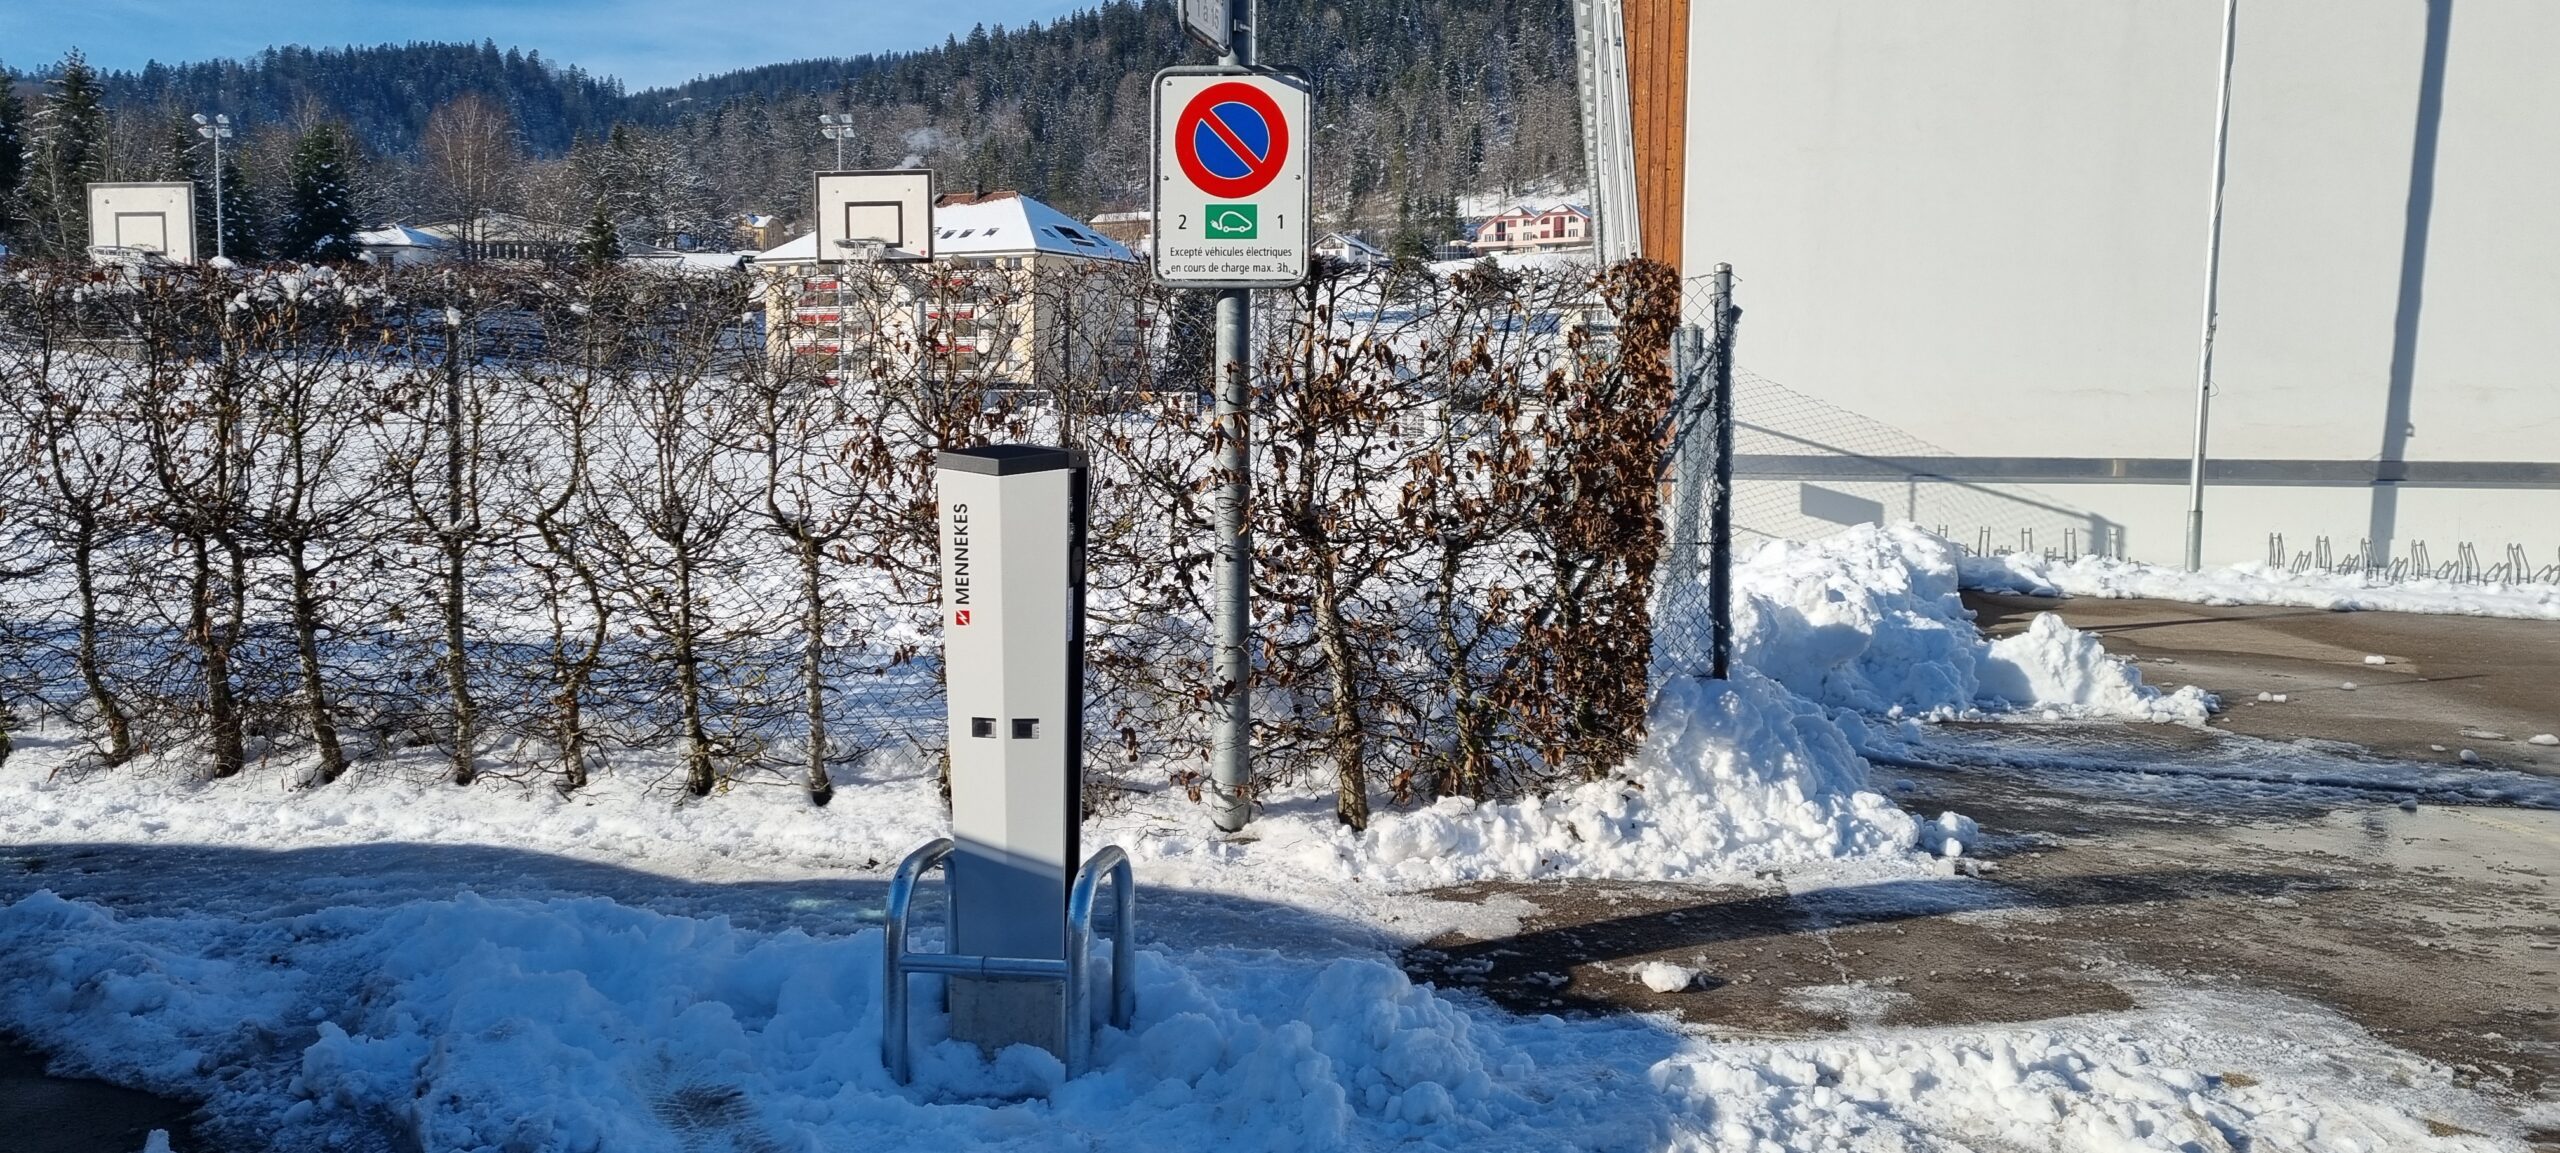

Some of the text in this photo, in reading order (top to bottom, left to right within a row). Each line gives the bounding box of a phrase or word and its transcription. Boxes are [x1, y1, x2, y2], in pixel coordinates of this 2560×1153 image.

[1211, 6, 1219, 30] 15
[1178, 214, 1284, 230] 2 1
[1170, 246, 1292, 258] Excepté véhicules électriques
[1171, 264, 1181, 273] en
[1183, 264, 1206, 273] cours
[1208, 262, 1219, 273] de
[1221, 262, 1250, 275] charge
[1252, 264, 1275, 273] max.
[953, 503, 970, 605] MENNEKES
